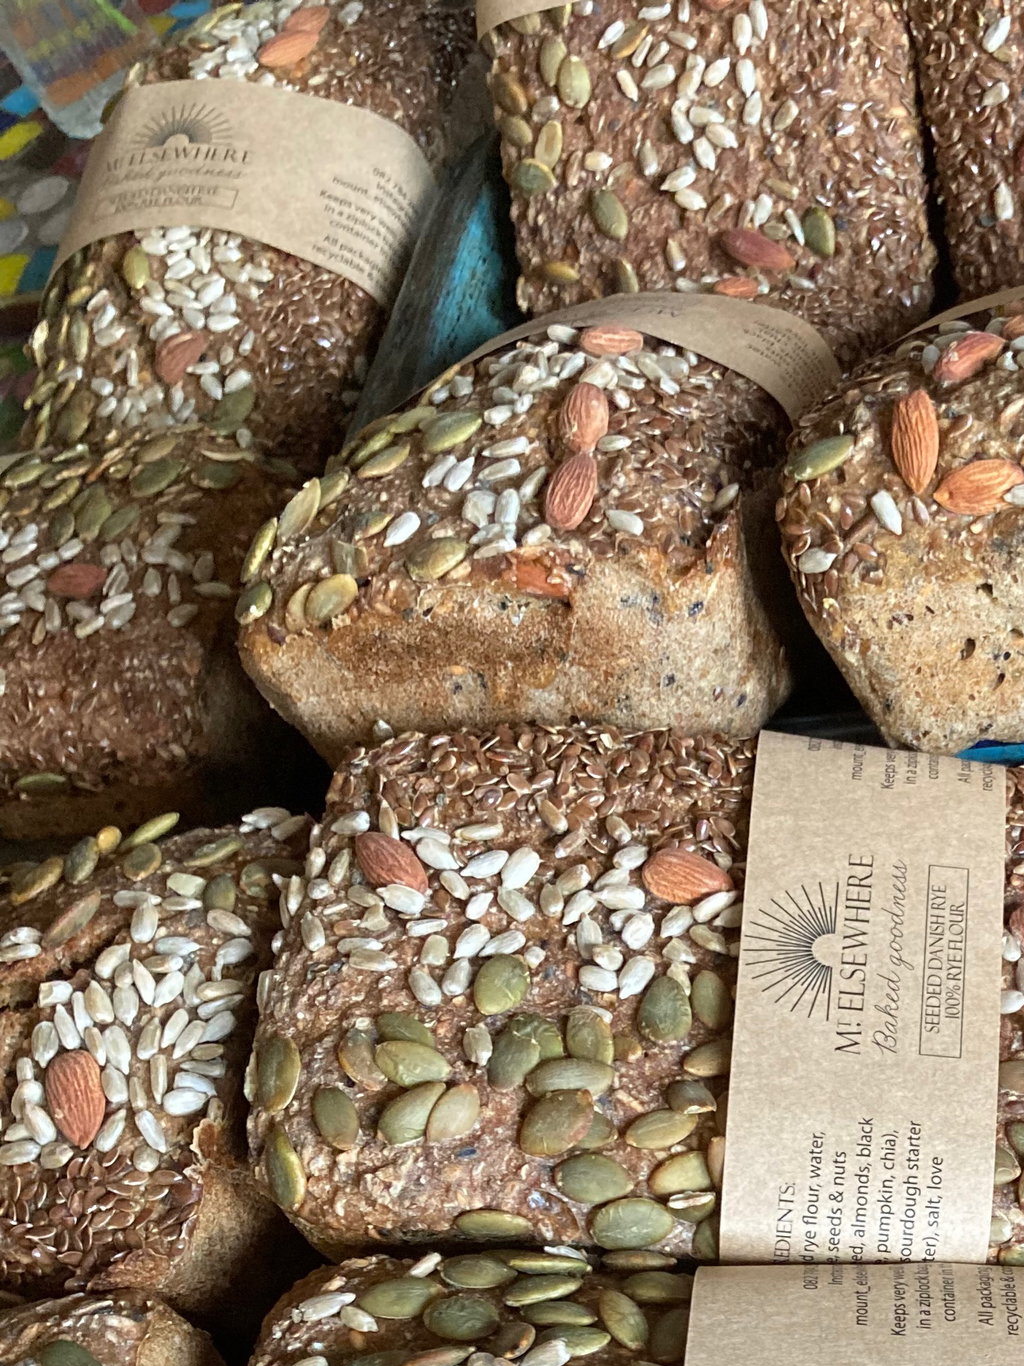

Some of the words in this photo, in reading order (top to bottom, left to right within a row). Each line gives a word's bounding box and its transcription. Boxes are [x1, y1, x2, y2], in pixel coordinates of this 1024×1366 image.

[881, 764, 897, 790] Keeps
[956, 772, 975, 785] All
[882, 859, 915, 971] goodness
[931, 884, 947, 914] RYE
[838, 853, 874, 1013] ELSEWHERE
[927, 914, 946, 972] DANISH
[948, 902, 965, 951] FLOUR
[947, 954, 963, 981] RYE
[871, 972, 902, 1056] Baked
[924, 974, 942, 1034] SEEDED
[945, 983, 961, 1020] 100%
[809, 1131, 826, 1180] water,
[856, 1117, 874, 1158] black
[880, 1129, 899, 1170] chia),
[906, 1120, 923, 1171] starter
[831, 1151, 847, 1186] nuts
[927, 1156, 944, 1190] love
[803, 1184, 822, 1227] flour,
[829, 1189, 844, 1202] &
[851, 1165, 872, 1238] almonds,
[874, 1175, 897, 1254] pumpkin,
[924, 1193, 943, 1228] salt,
[803, 1228, 817, 1254] rye
[828, 1205, 843, 1253] seeds
[900, 1178, 920, 1263] sourdough
[922, 1231, 938, 1263] ter),
[893, 1281, 908, 1302] very
[915, 1276, 934, 1308] ziplock
[940, 1277, 957, 1322] container
[1000, 1284, 1022, 1337] recyclable
[890, 1304, 908, 1337] Keeps
[917, 1318, 932, 1330] in
[977, 1311, 994, 1327] All
